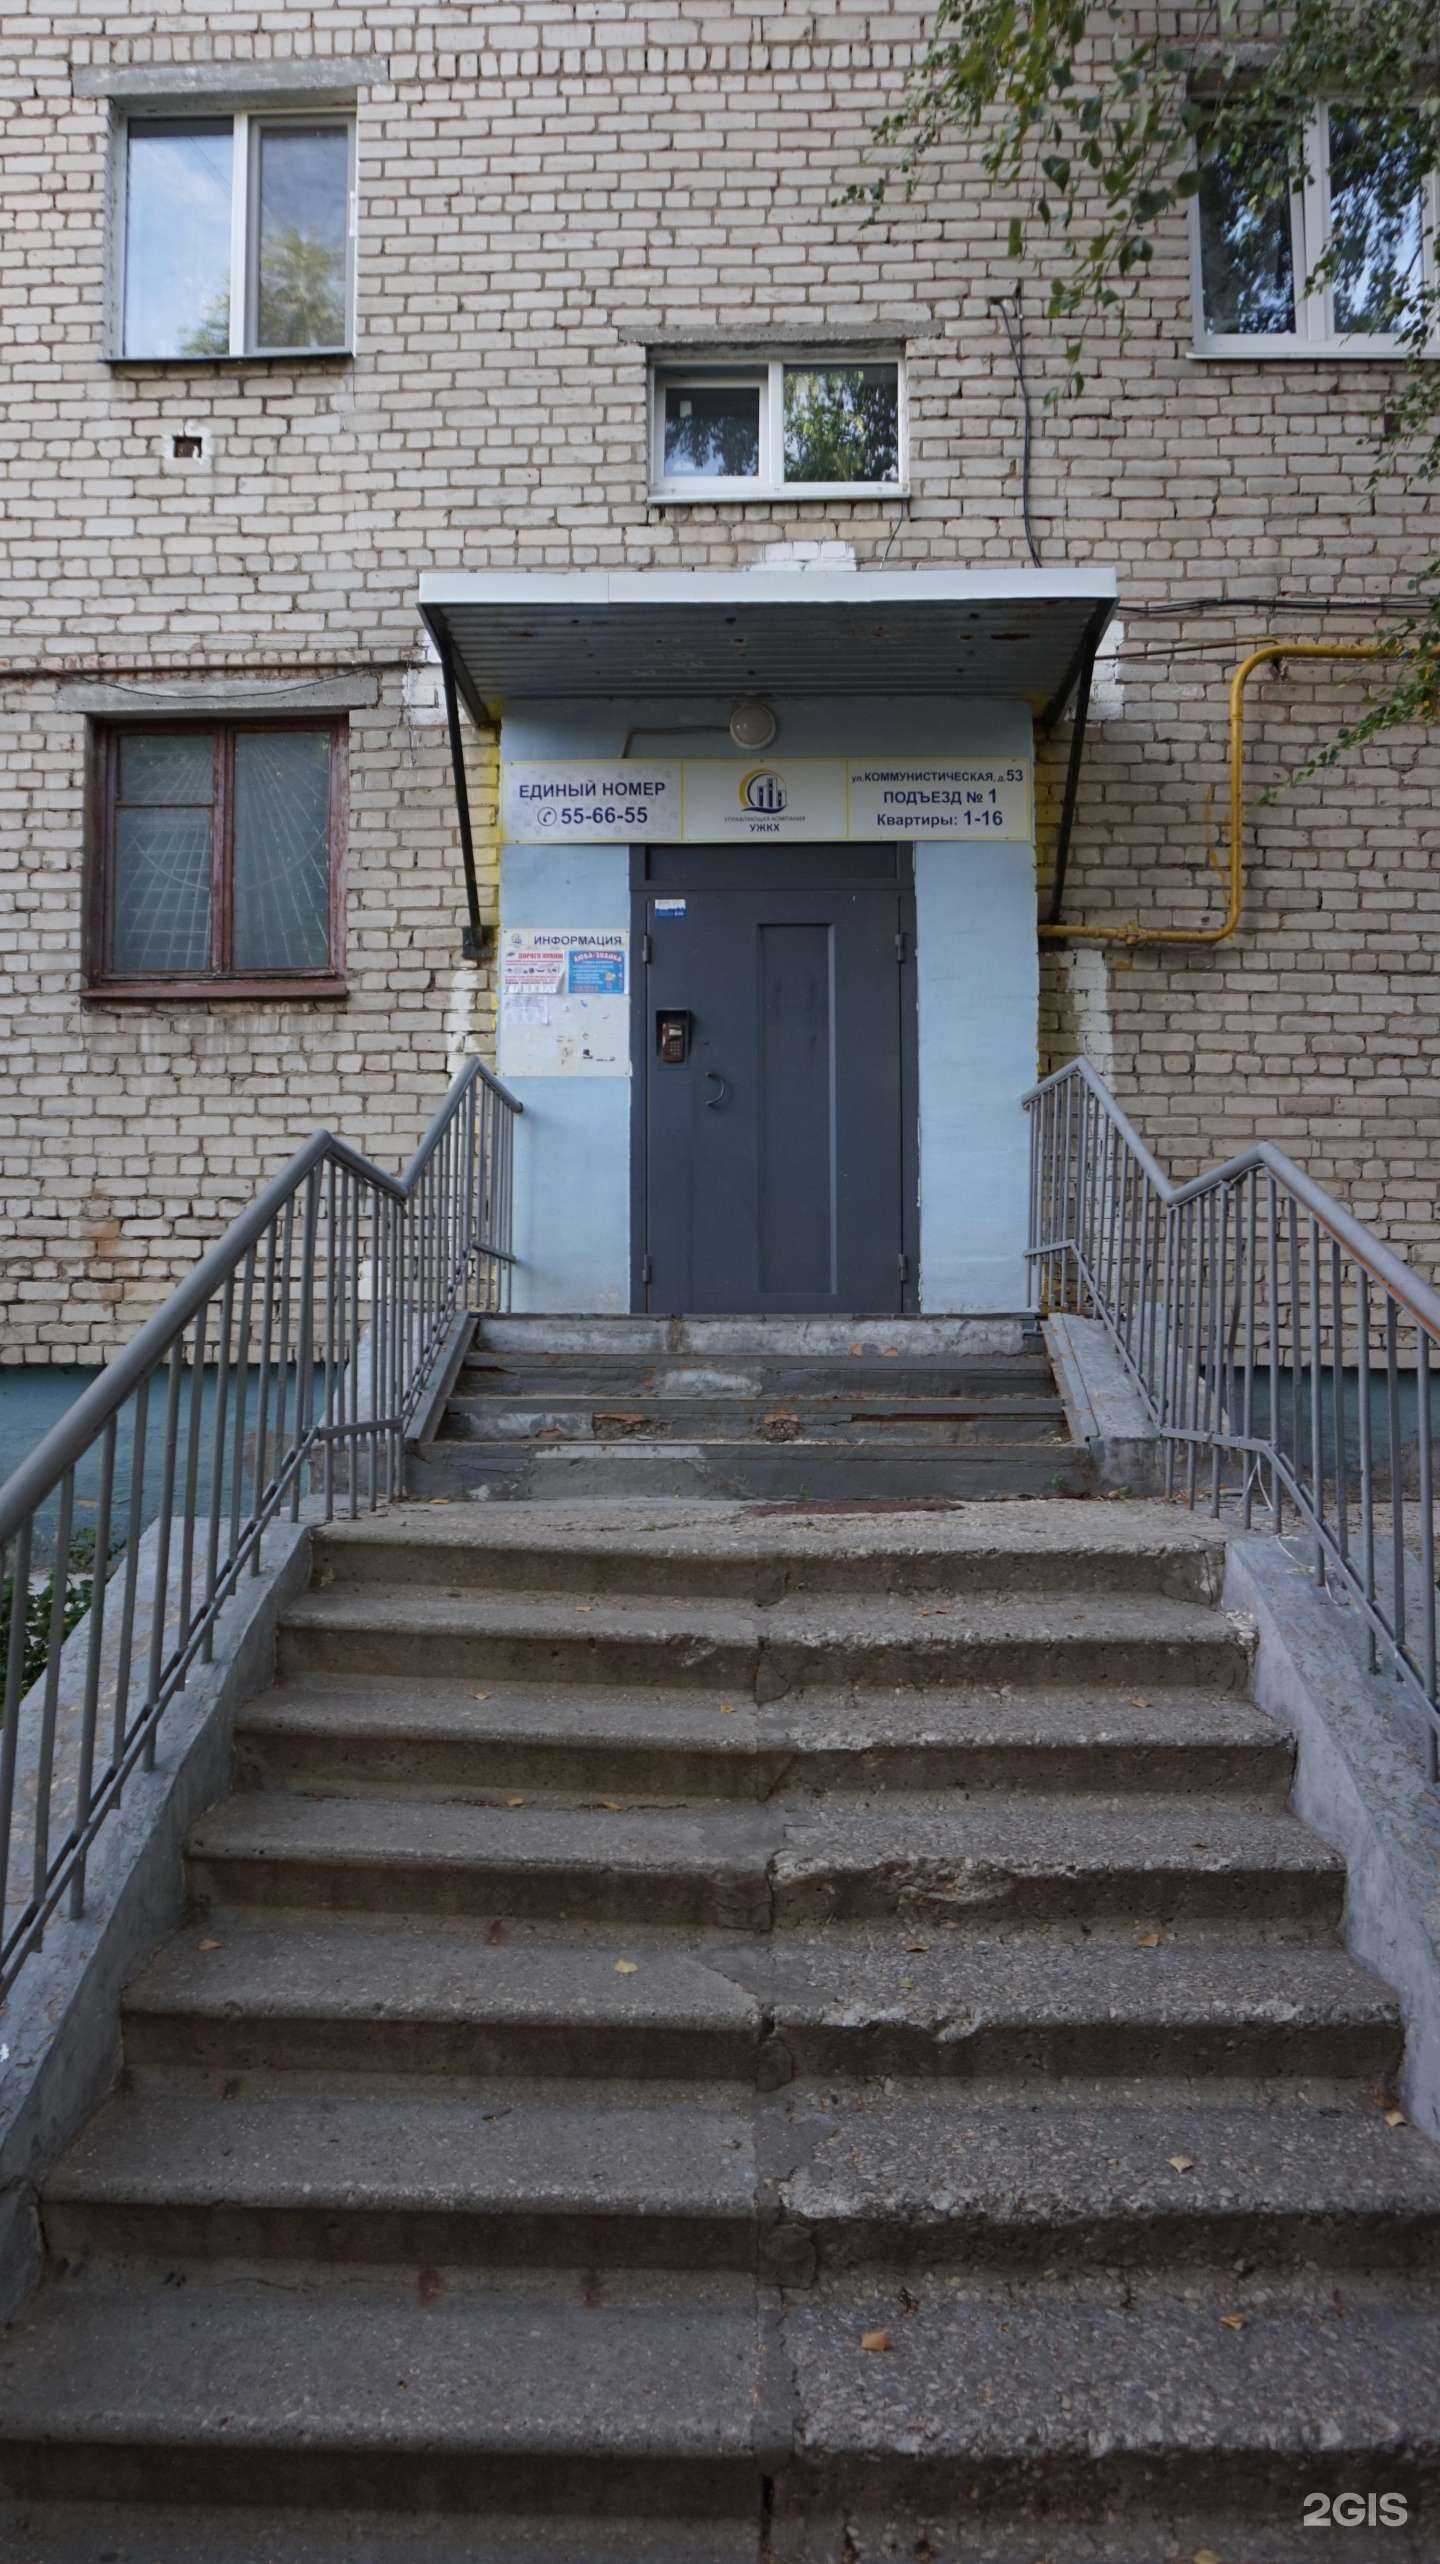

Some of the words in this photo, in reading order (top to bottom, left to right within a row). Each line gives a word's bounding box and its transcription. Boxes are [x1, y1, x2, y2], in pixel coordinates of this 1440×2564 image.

[519, 780, 596, 800] ЕДИНЫЙ
[602, 782, 666, 796] НОМЕР
[884, 791, 962, 805] ПОДЪЕЗД
[966, 791, 983, 803] №
[988, 788, 997, 803] 1
[561, 807, 648, 824] 55-66-55
[877, 814, 958, 827] Квартиры:
[963, 811, 1003, 826] 1-16
[749, 824, 780, 832] УЖКХ
[534, 936, 622, 946] ИНФОРМАЦИЯ
